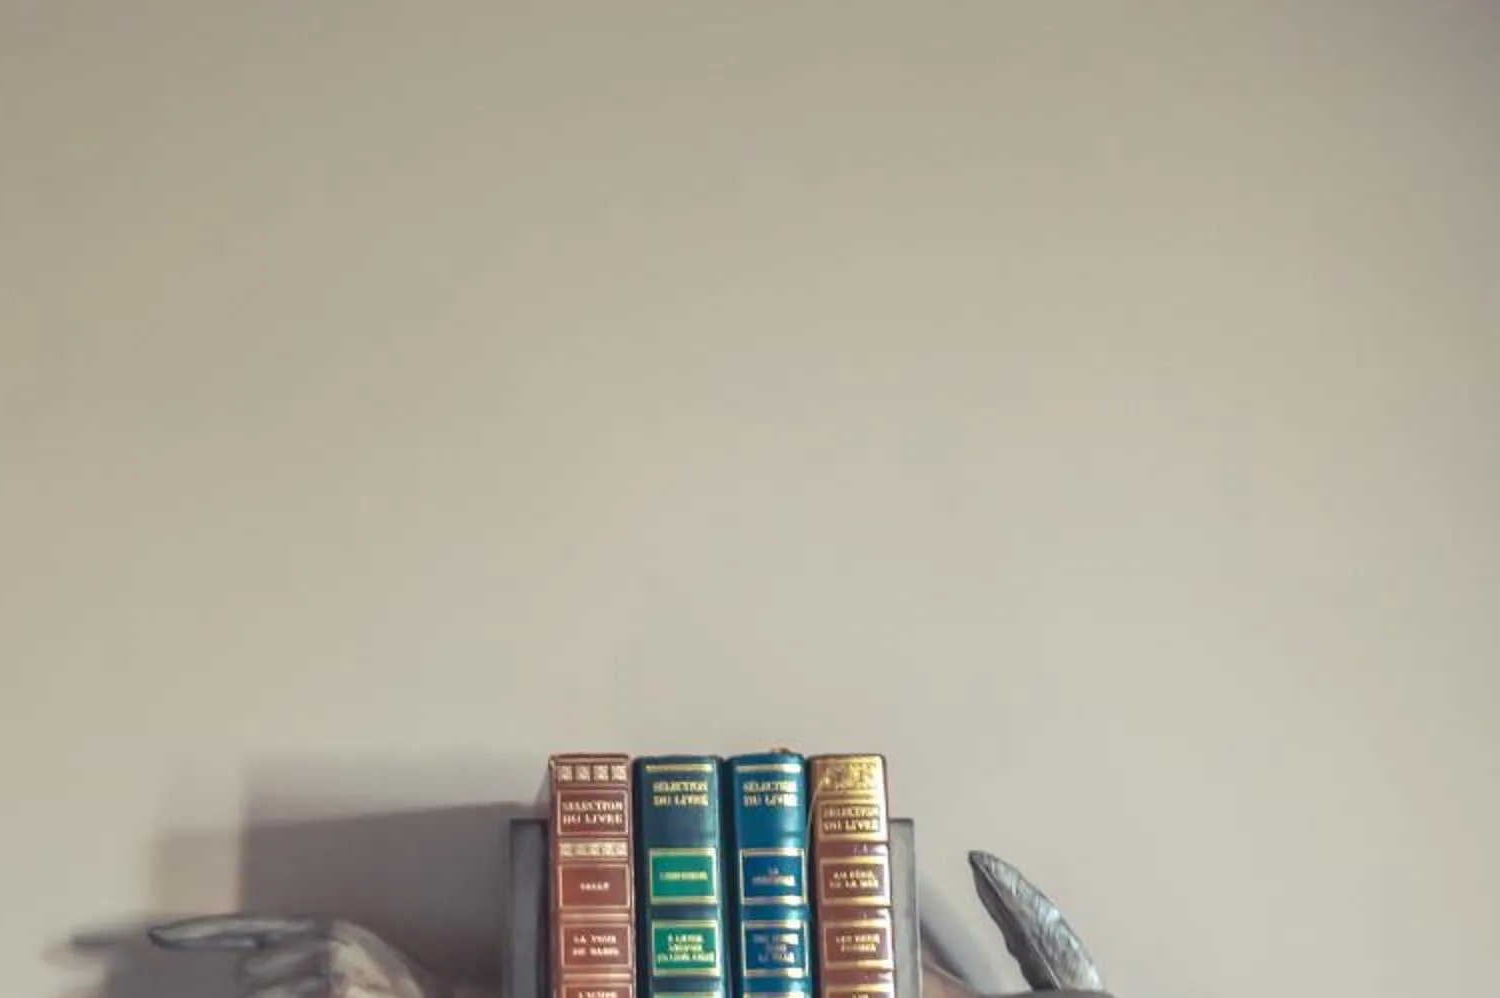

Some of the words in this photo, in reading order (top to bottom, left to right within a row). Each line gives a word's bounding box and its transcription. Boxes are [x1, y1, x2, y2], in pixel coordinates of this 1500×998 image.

[743, 780, 798, 793] SELECTI
[764, 794, 798, 807] LIV
[585, 813, 623, 825] LIVRE
